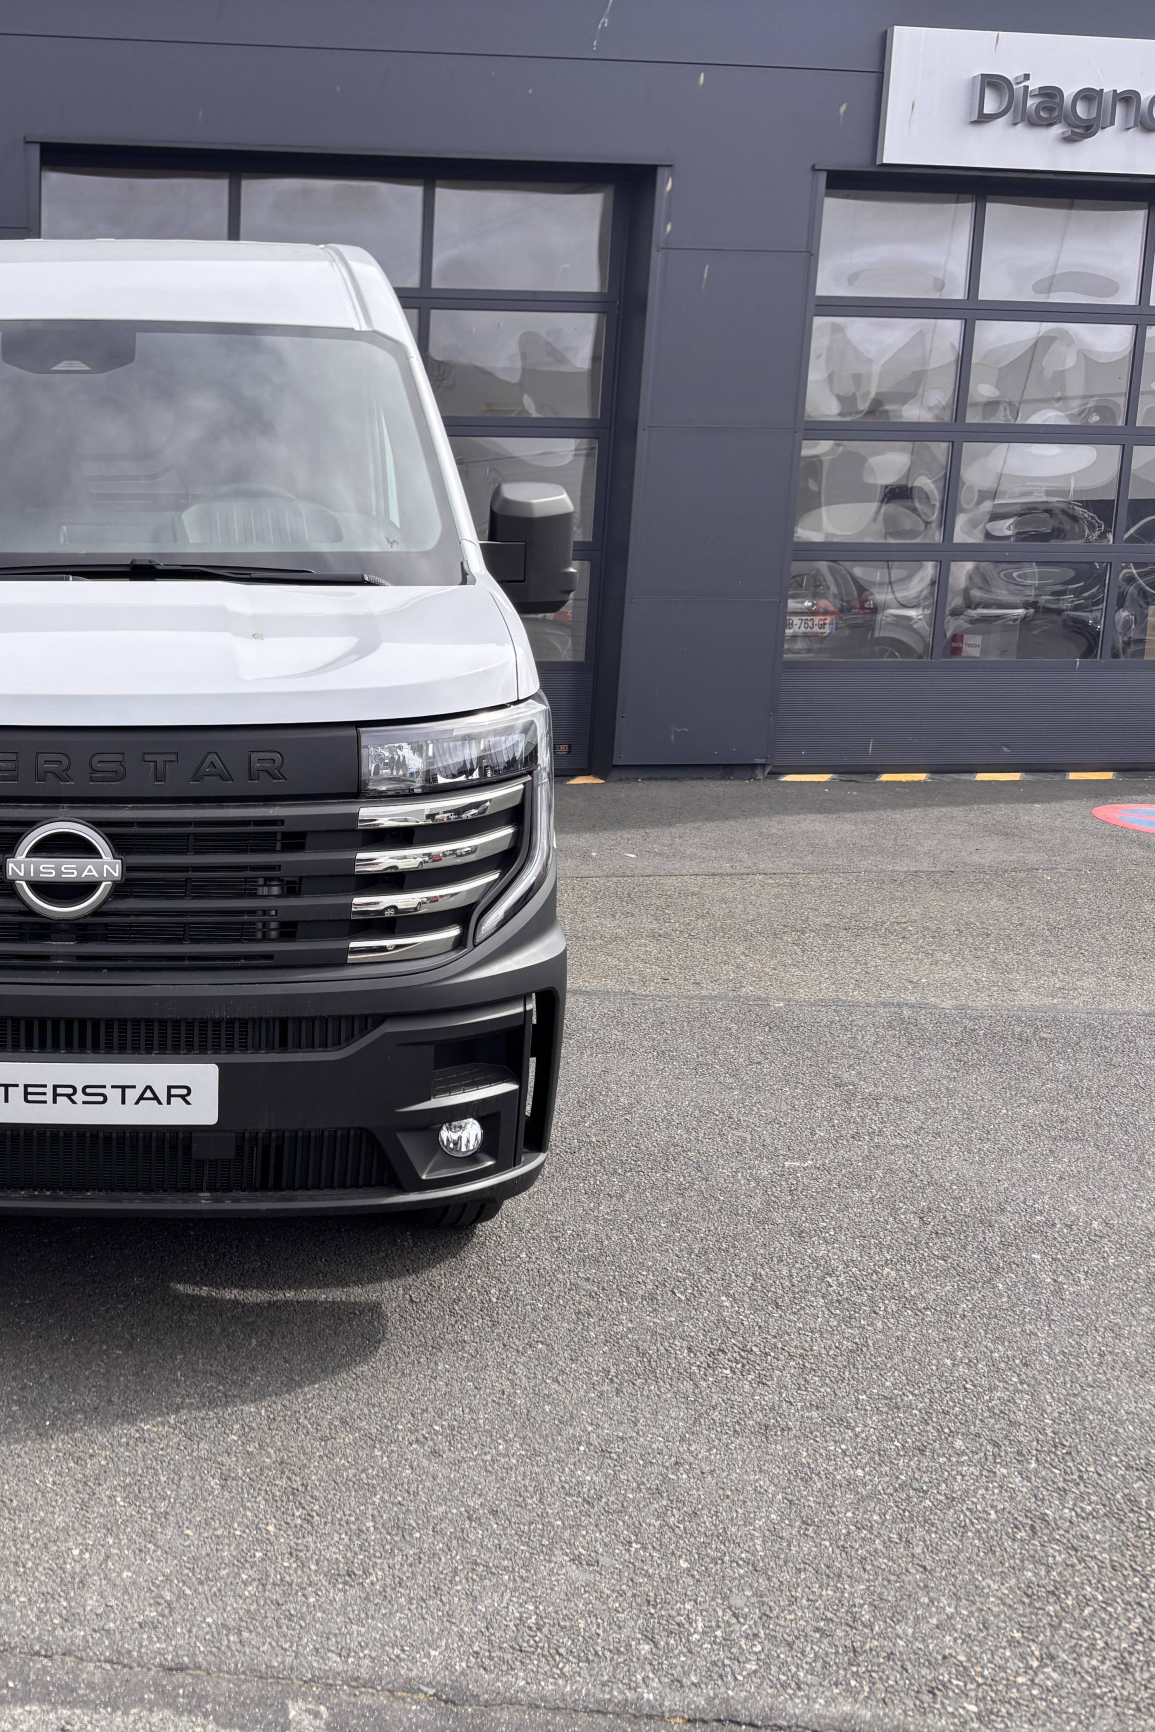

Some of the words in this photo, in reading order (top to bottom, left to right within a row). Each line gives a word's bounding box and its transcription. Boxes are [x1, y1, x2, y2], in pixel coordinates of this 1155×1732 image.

[970, 73, 1155, 142] Diagn
[787, 617, 829, 630] B-763-GF
[8, 862, 119, 878] NISSAN
